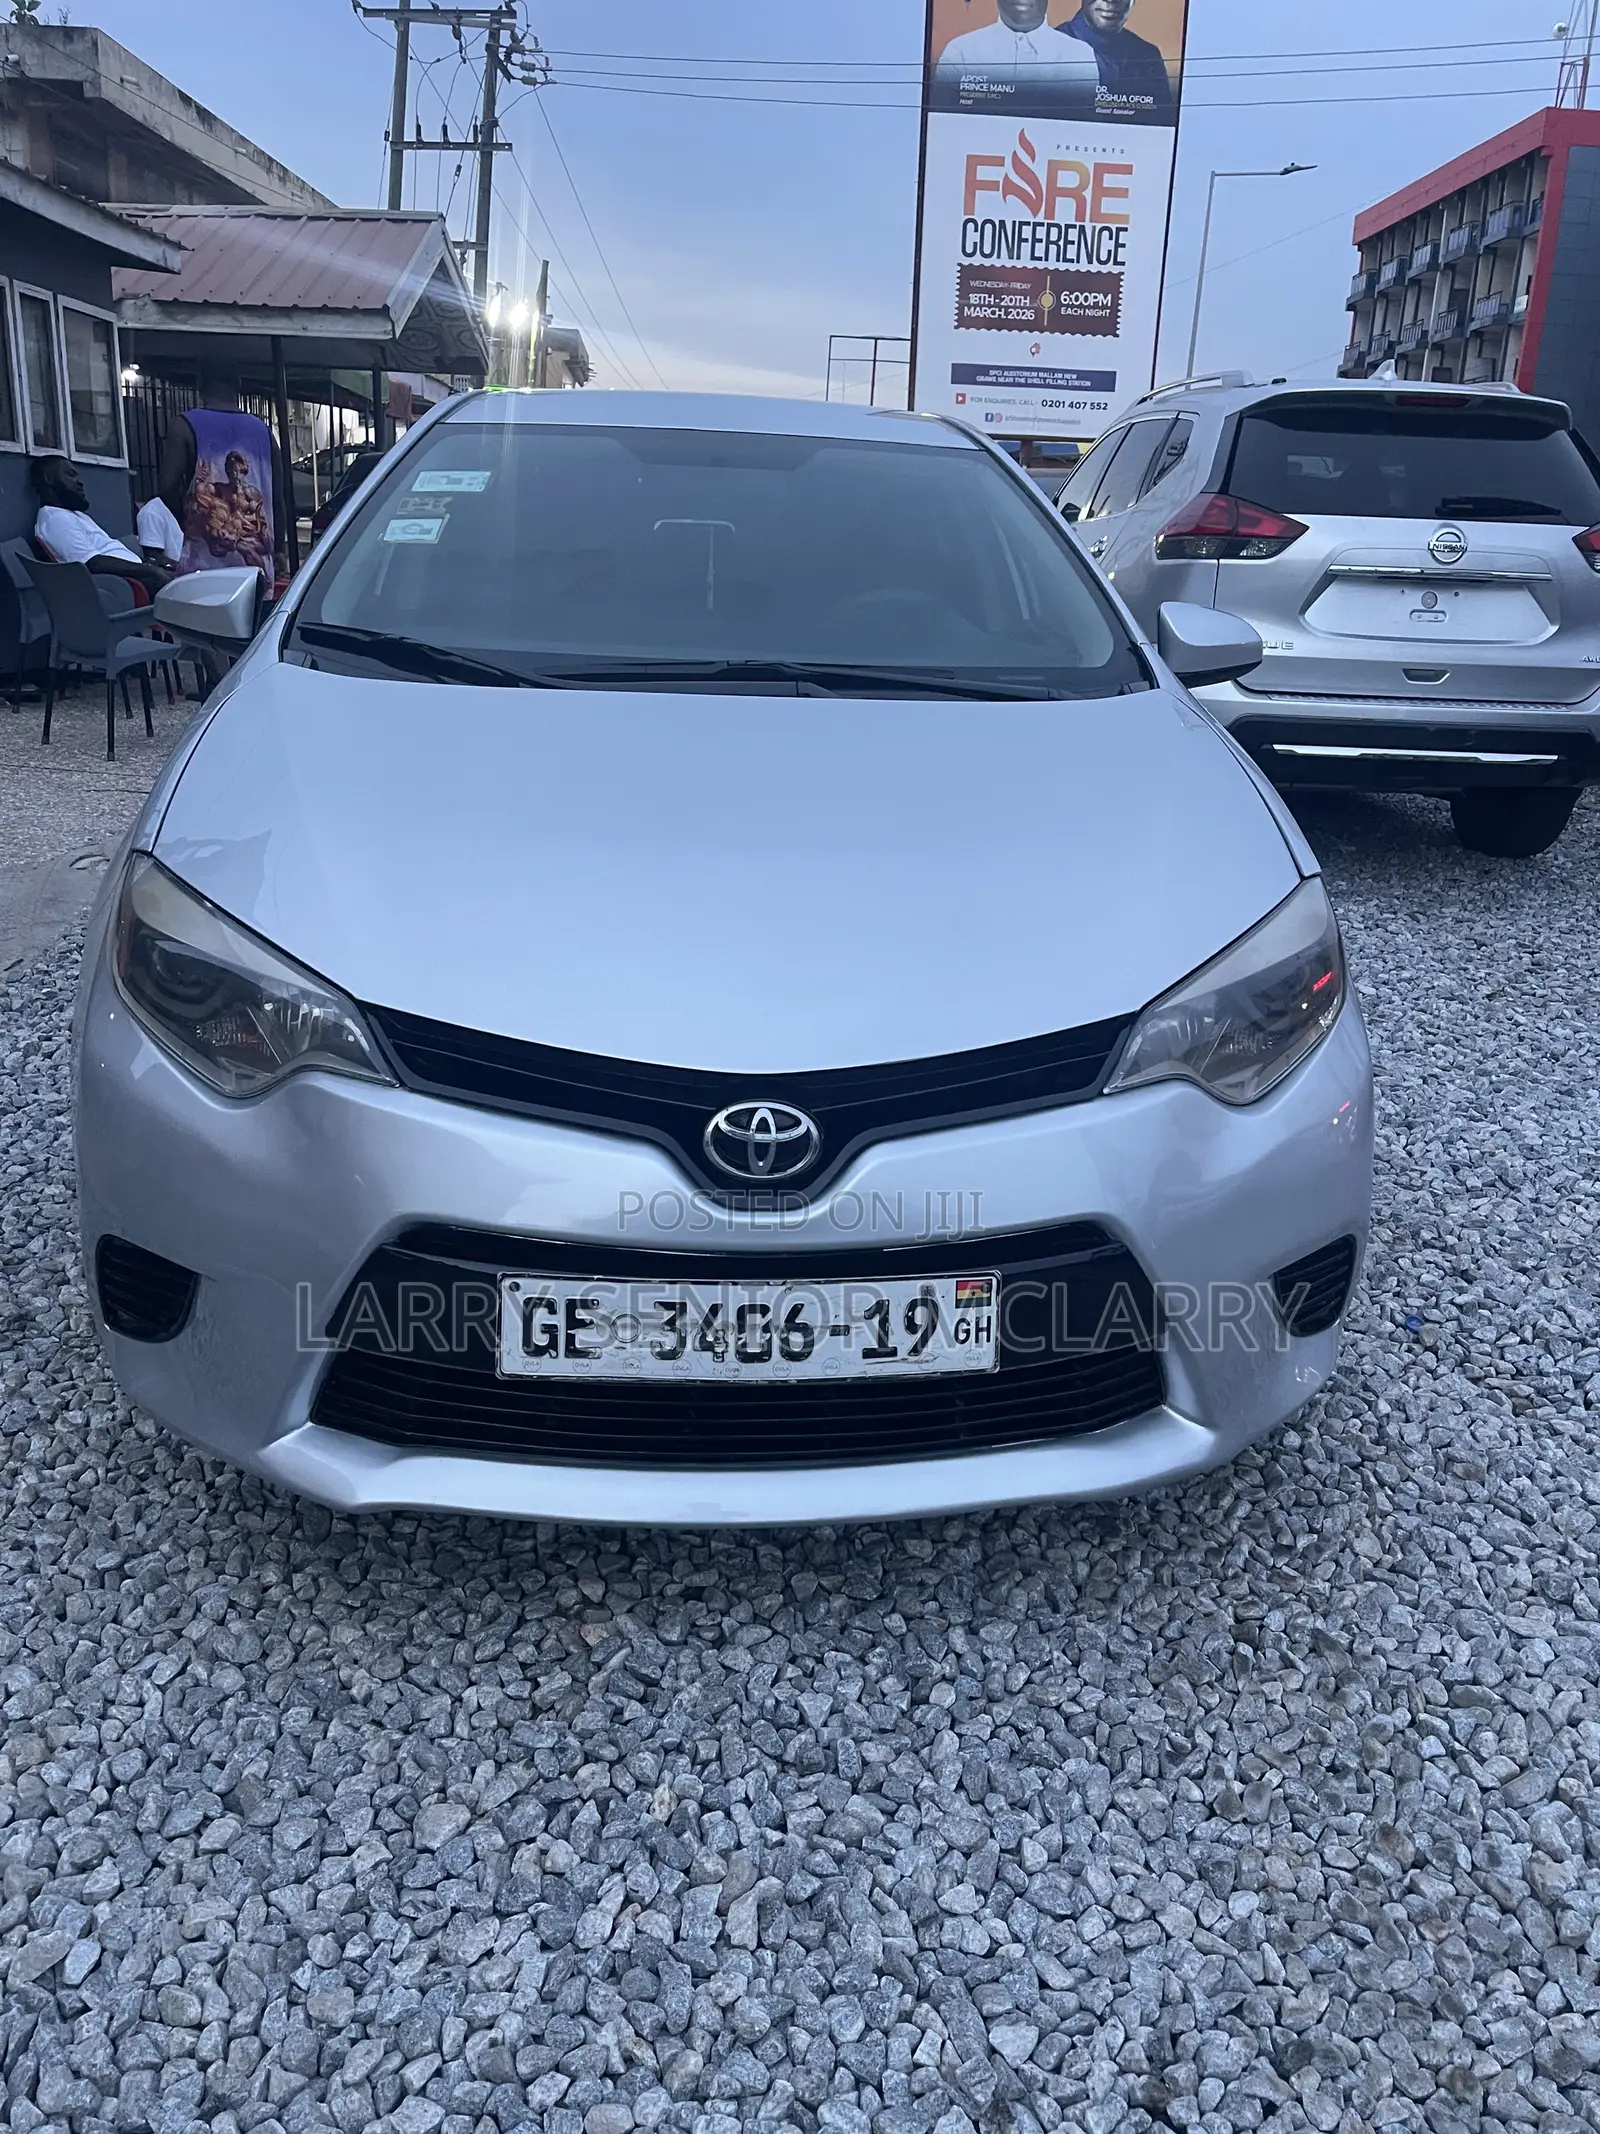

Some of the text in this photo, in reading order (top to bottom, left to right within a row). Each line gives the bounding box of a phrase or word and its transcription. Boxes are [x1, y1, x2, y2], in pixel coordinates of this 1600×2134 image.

[960, 83, 1015, 93] PRINCE MANU
[1095, 93, 1154, 104] JOSHUA OFORI
[1056, 144, 1125, 154] PRESENTS
[961, 217, 1129, 267] CONFERENCE
[969, 294, 994, 305] 18TH
[1000, 295, 1030, 307] 20TH
[1061, 291, 1112, 307] 6:00PM
[1007, 309, 1036, 320] 2026
[1061, 307, 1111, 317] EACH NIGHT
[1041, 399, 1066, 409] 0201
[1067, 401, 1088, 410] 407
[1089, 402, 1109, 411] 552
[1432, 543, 1464, 551] NISSAN
[954, 1315, 992, 1345] GH
